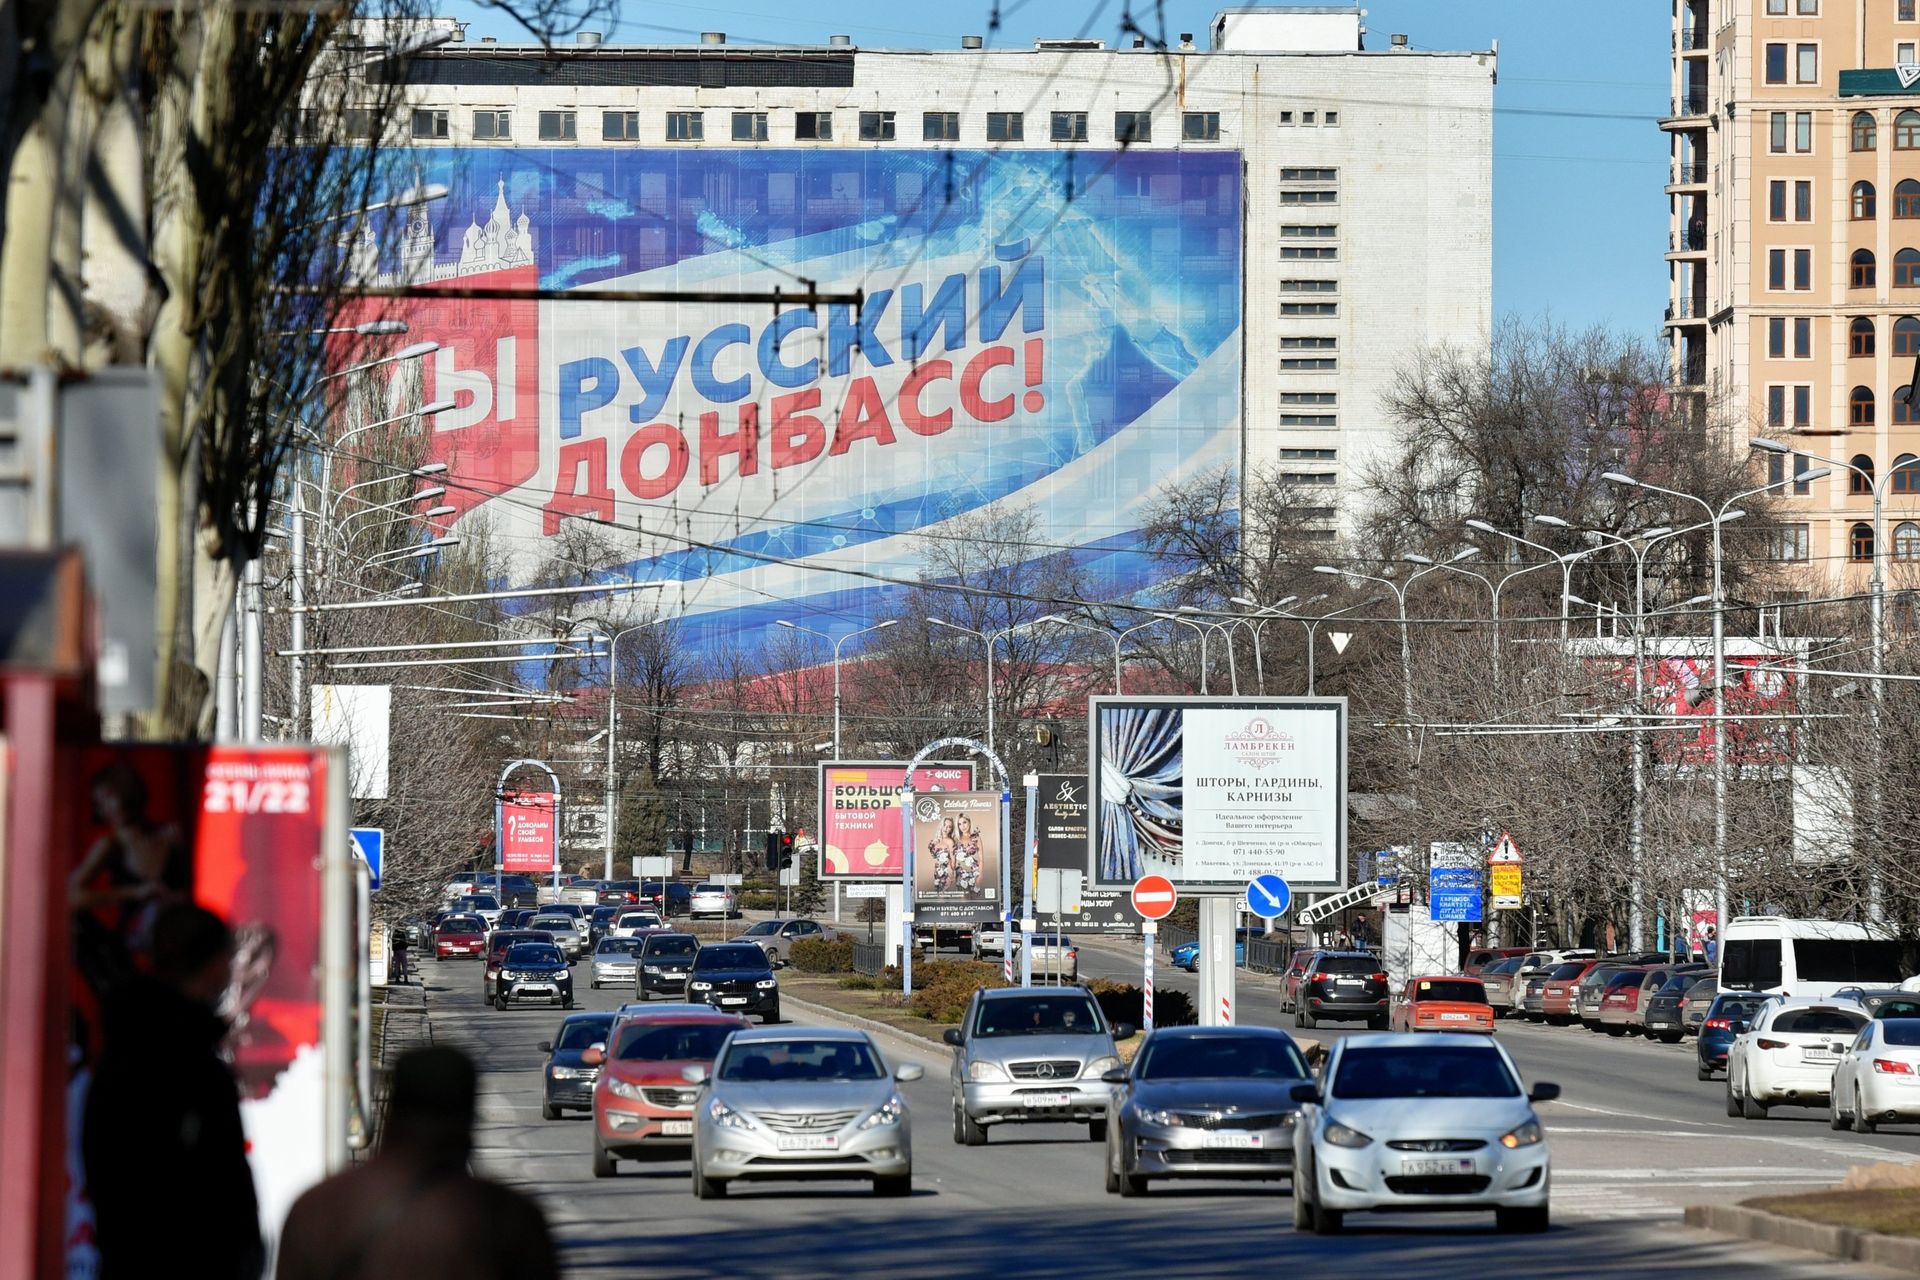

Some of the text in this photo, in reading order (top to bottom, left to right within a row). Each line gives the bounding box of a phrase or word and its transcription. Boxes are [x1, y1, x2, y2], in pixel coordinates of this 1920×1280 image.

[559, 237, 1045, 440] РУССКИЙ
[542, 337, 1045, 537] ДОНБАСС!
[1254, 723, 1264, 734] Л
[1223, 742, 1295, 751] ЛАМБРЕКЕН
[934, 770, 962, 779] ФОКС
[1196, 777, 1323, 790] ШТОРЫ, ГАРДИНЫ,
[834, 784, 917, 797] БОЛЬШО
[203, 780, 310, 814] 21/22
[1227, 791, 1293, 802] КАРНИЗЫ
[834, 799, 892, 810] ВЫБОР
[1043, 802, 1088, 810] AESTHETIC
[834, 811, 876, 820] БЫТОВОЙ
[1215, 813, 1303, 822] Идеальное оформление
[834, 821, 874, 830] ТЕХНИКИ
[1225, 822, 1293, 831] Вашего интерьера
[1233, 848, 1285, 856] 071 440-55-90
